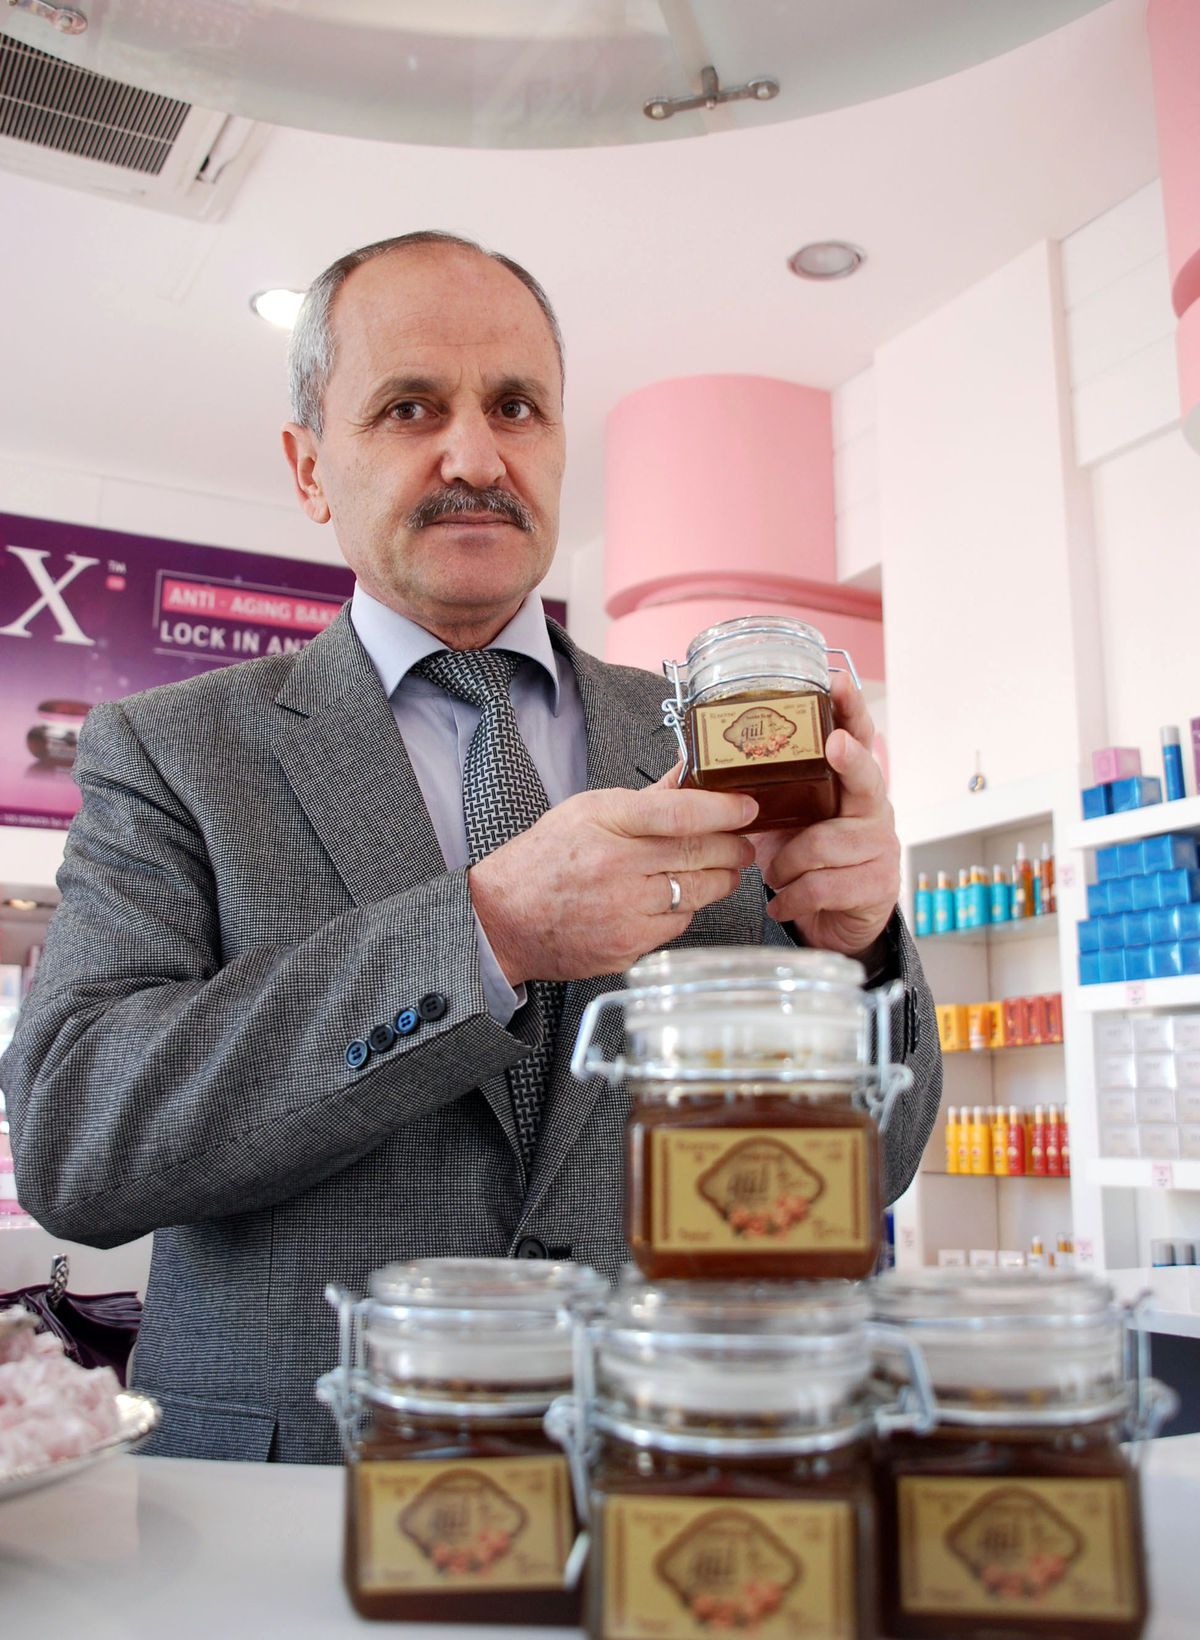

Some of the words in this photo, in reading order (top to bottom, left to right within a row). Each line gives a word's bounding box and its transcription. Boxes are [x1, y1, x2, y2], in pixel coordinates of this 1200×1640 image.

[0, 545, 100, 646] X
[169, 586, 216, 609] ANTI
[230, 596, 292, 621] AGING
[160, 619, 226, 649] LOCK
[233, 629, 260, 653] IN
